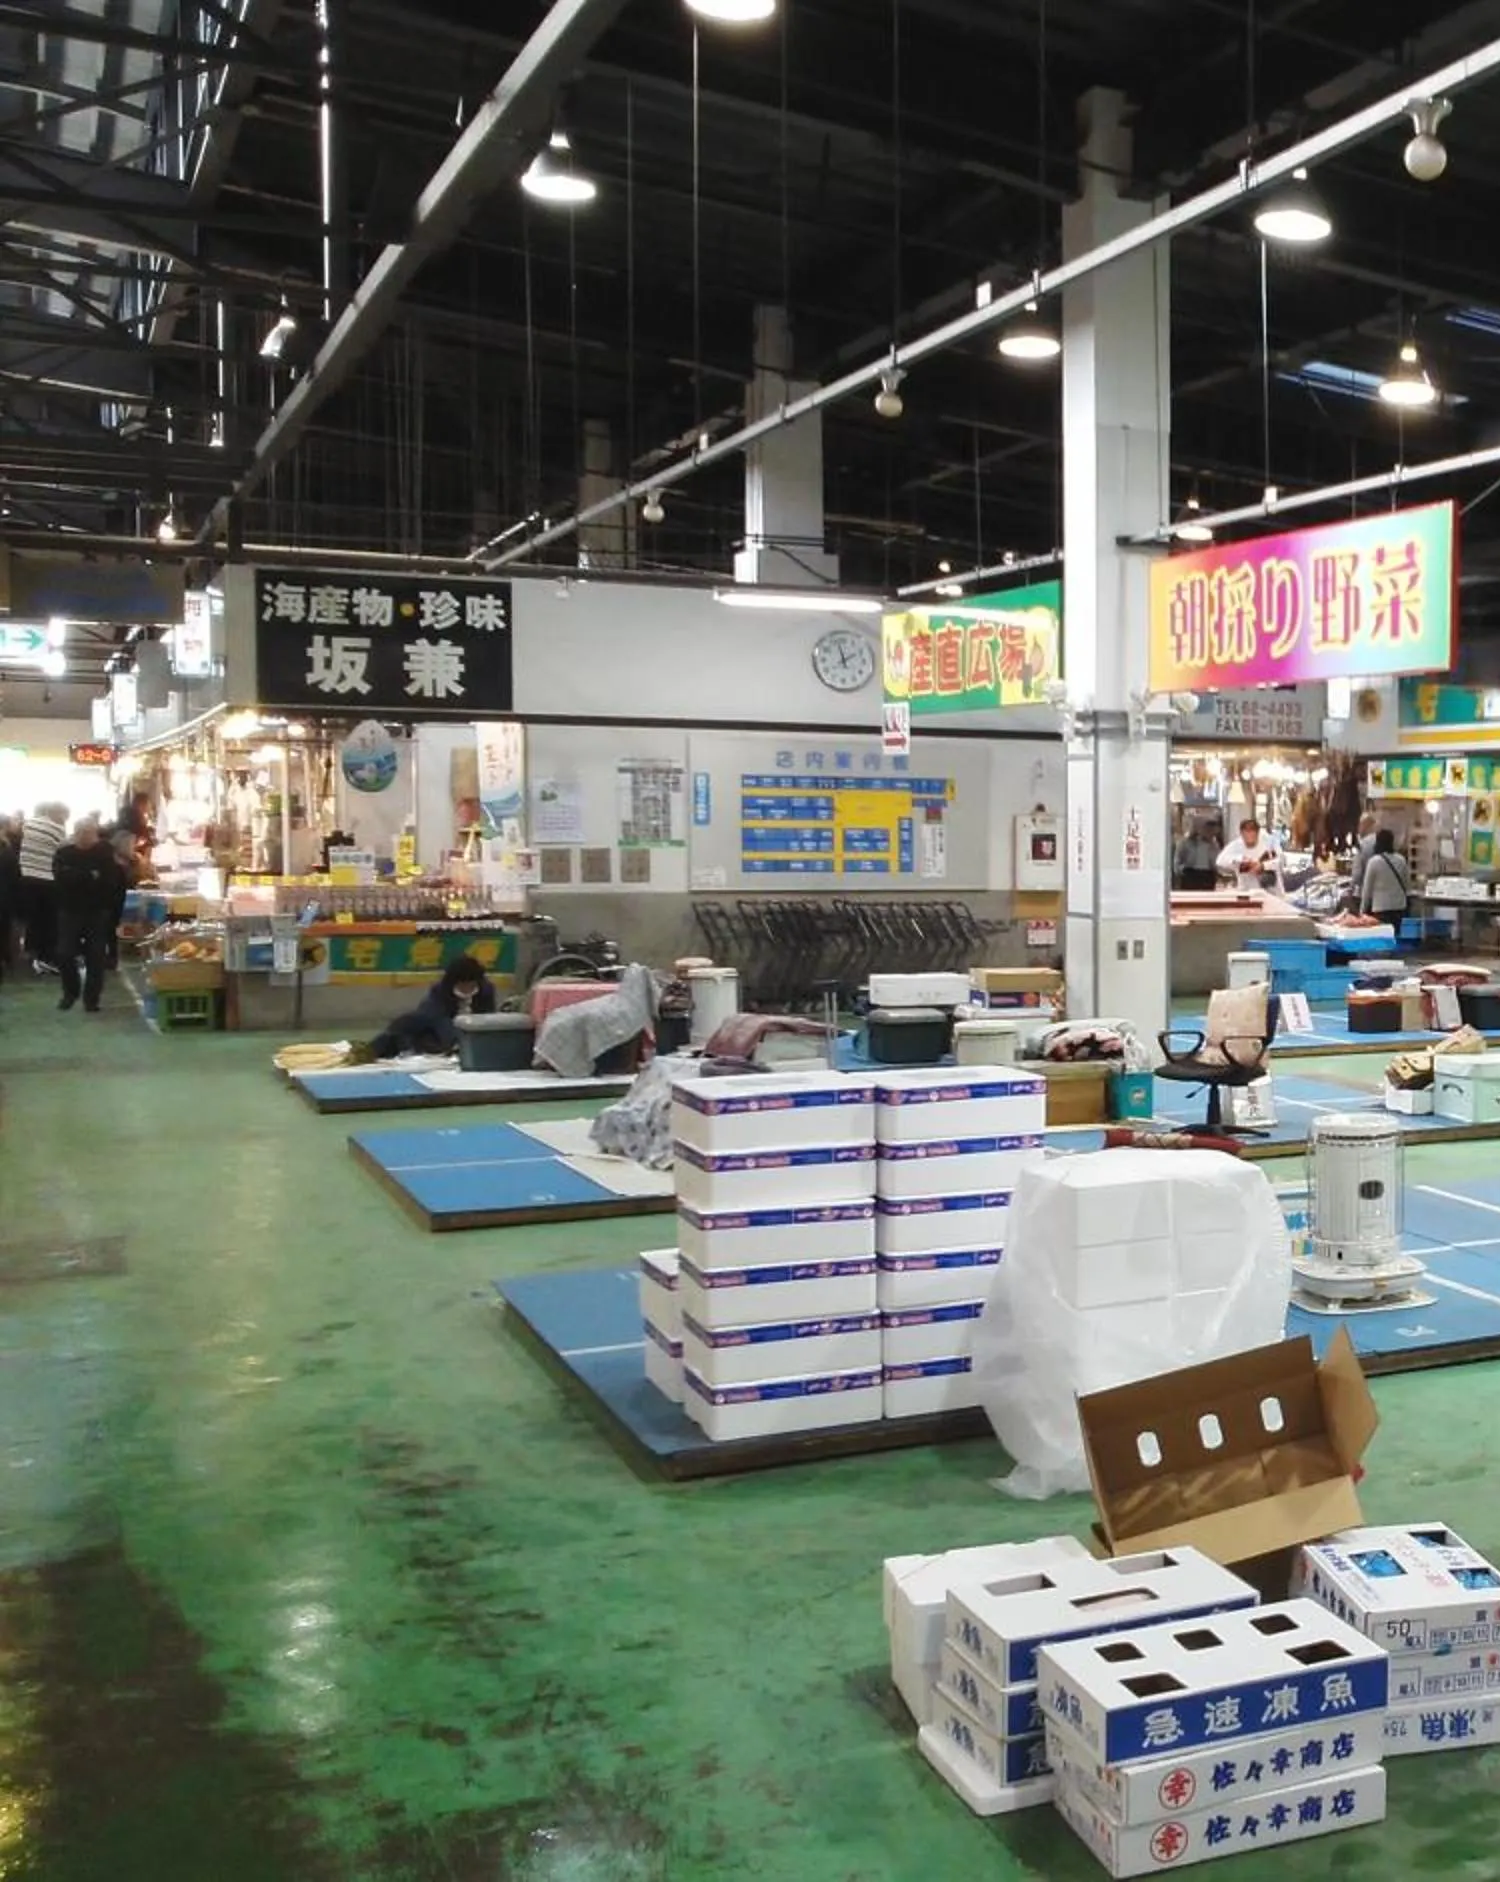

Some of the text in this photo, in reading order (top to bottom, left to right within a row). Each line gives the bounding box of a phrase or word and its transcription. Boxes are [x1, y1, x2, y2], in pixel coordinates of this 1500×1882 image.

[261, 581, 506, 632] 海産物・珍味
[1168, 540, 1423, 666] 朝採り野菜
[911, 620, 1027, 693] 産直広場
[1142, 1672, 1356, 1748] 急速凍魚
[1209, 1732, 1356, 1792] 佐々幸商店
[1204, 1789, 1357, 1846] 佐々幸商店
